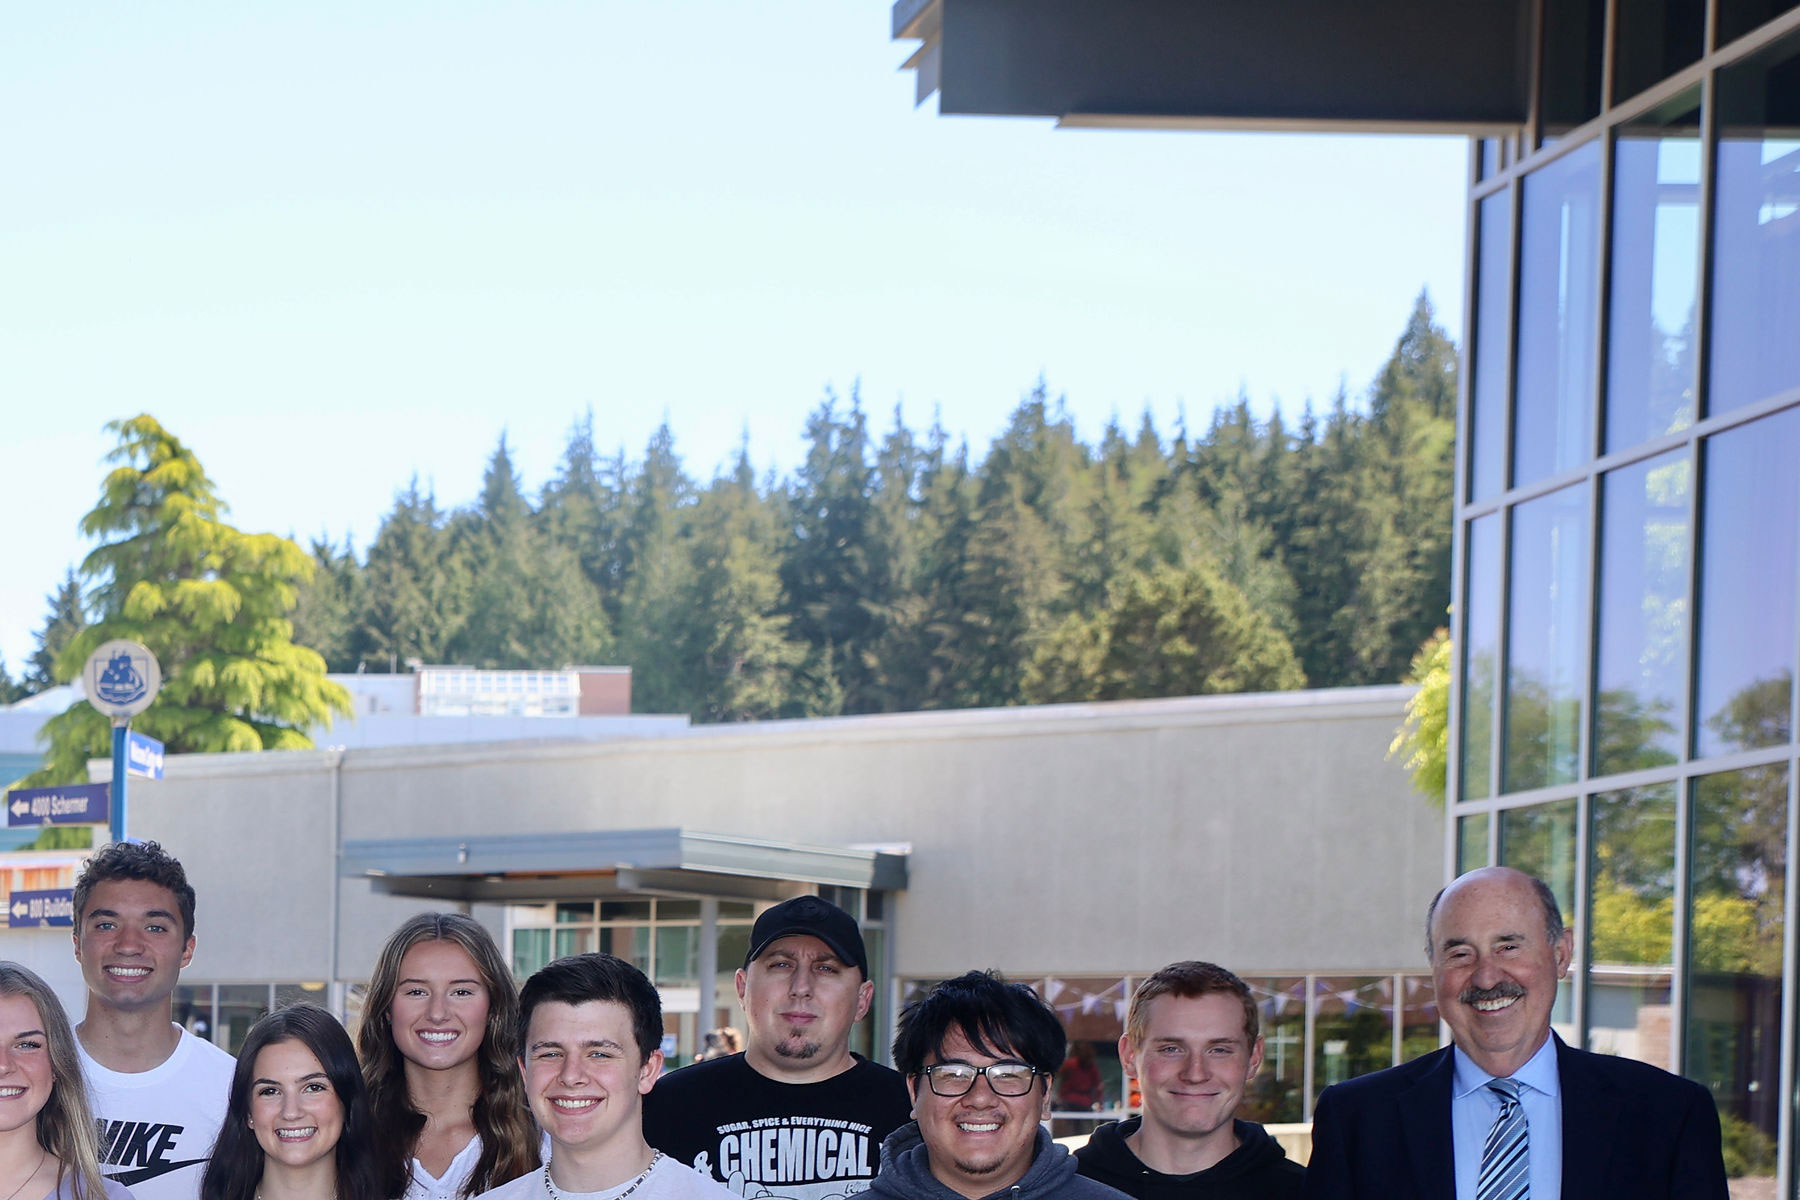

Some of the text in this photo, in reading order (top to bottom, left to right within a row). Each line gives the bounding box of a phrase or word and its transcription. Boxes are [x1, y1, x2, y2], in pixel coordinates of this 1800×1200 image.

[96, 1118, 184, 1168] NIKE
[716, 1116, 872, 1135] SUGAR, SPICE & EVERYTHING NICE
[719, 1128, 872, 1183] CHEMICAL
